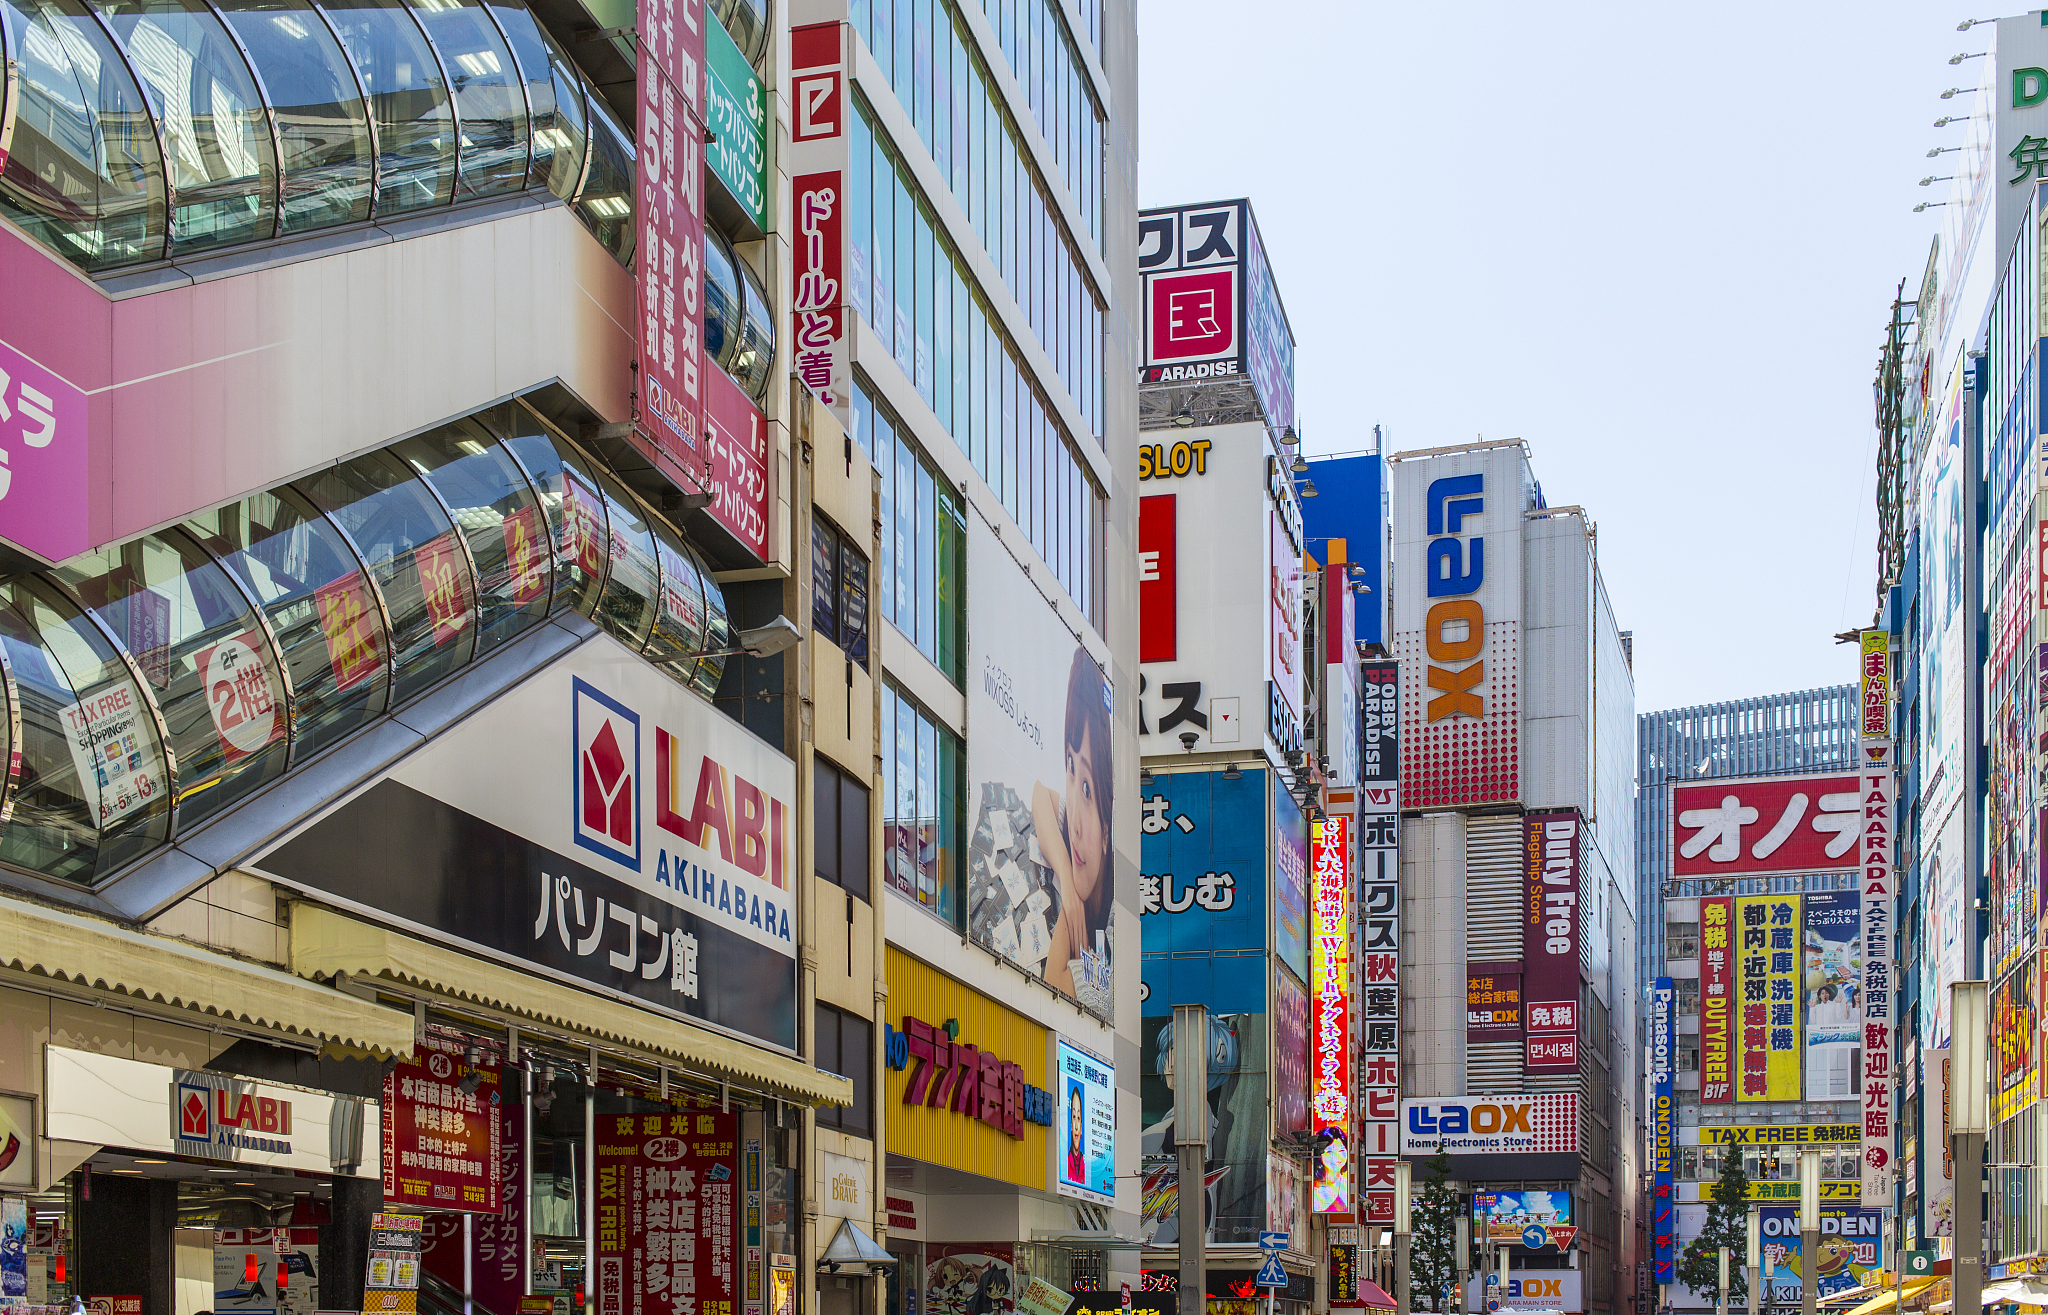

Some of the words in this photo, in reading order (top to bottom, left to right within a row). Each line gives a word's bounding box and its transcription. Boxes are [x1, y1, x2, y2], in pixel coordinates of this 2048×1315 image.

[746, 77, 765, 128] 3F
[707, 74, 764, 175] トップパソコン
[681, 234, 699, 401] 상점
[1150, 361, 1238, 383] PARADISE
[664, 388, 696, 441] LABI
[664, 414, 696, 452] AKIHABARA
[1139, 439, 1212, 482] SLOT
[667, 581, 697, 628] FREE
[220, 646, 239, 671] 2F
[67, 701, 99, 730] TAX
[98, 687, 132, 718] FREE
[983, 668, 1015, 719] WIXOSS
[1381, 669, 1397, 740] HOBBY
[1864, 650, 1889, 735] まんが喫茶
[93, 715, 118, 731] Particular
[116, 709, 131, 722] Items
[1365, 669, 1381, 777] PARADISE
[656, 725, 789, 893] LABI
[1528, 822, 1543, 881] Flagship
[1543, 820, 1576, 886] Duty
[1865, 774, 1888, 896] TAKARADA
[655, 848, 792, 943] AKIHABARA
[1530, 885, 1543, 925] Store
[1807, 908, 1860, 918] スペースそのま
[534, 871, 699, 1000] パソコン館
[1545, 891, 1576, 955] Free
[1704, 903, 1729, 950] 免税
[1807, 915, 1856, 926] たっぷり入る。
[1468, 977, 1494, 991] 本店
[1468, 989, 1519, 1005] 総合家電
[1865, 960, 1889, 1019] 免税商店
[1531, 1006, 1574, 1028] 免税
[1655, 988, 1673, 1084] Panasonic
[1530, 1042, 1574, 1060] 면세점
[903, 1015, 1025, 1142] ラジオ会館
[1024, 1082, 1053, 1128] 秋葉原
[1703, 1083, 1730, 1100] B1F
[1864, 1022, 1889, 1139] 歓迎光臨
[217, 1089, 293, 1136] LABI
[616, 1114, 716, 1136] 欢迎光临
[217, 1131, 293, 1155] AKIHABARA
[417, 1135, 468, 1156] 日本的土特产
[598, 1143, 639, 1157] Welcome!
[1407, 1137, 1438, 1149] Home
[1441, 1136, 1500, 1148] Electronics
[1503, 1136, 1533, 1147] Store
[1657, 1094, 1672, 1173] ONODEN
[1709, 1127, 1751, 1143] TAX
[1755, 1126, 1809, 1142] FREE
[1813, 1125, 1861, 1142] 免税店
[401, 1150, 483, 1177] 海外可使用的家用电器
[600, 1164, 618, 1199] TAX
[403, 1183, 414, 1195] TAX
[415, 1184, 428, 1197] FREE
[440, 1185, 456, 1196] LABI
[632, 1165, 643, 1236] 日本的土特产
[832, 1177, 858, 1204] BRAVE
[886, 1195, 915, 1215] KIHABARA
[1756, 1183, 1801, 1199] 冷蔵庫
[499, 1142, 520, 1282] デジタルカメラ
[600, 1205, 618, 1252] FREE
[1762, 1216, 1878, 1238] ONDEN
[1794, 1210, 1836, 1218] Wome
[1836, 1210, 1847, 1218] to
[386, 1233, 413, 1247] SoftBank
[645, 1165, 671, 1302] 种类繁多。
[1554, 1230, 1573, 1238] 止まれ
[1853, 1242, 1877, 1265] 迎
[114, 1299, 141, 1313] 火気厳禁
[602, 1260, 620, 1315] 免税品
